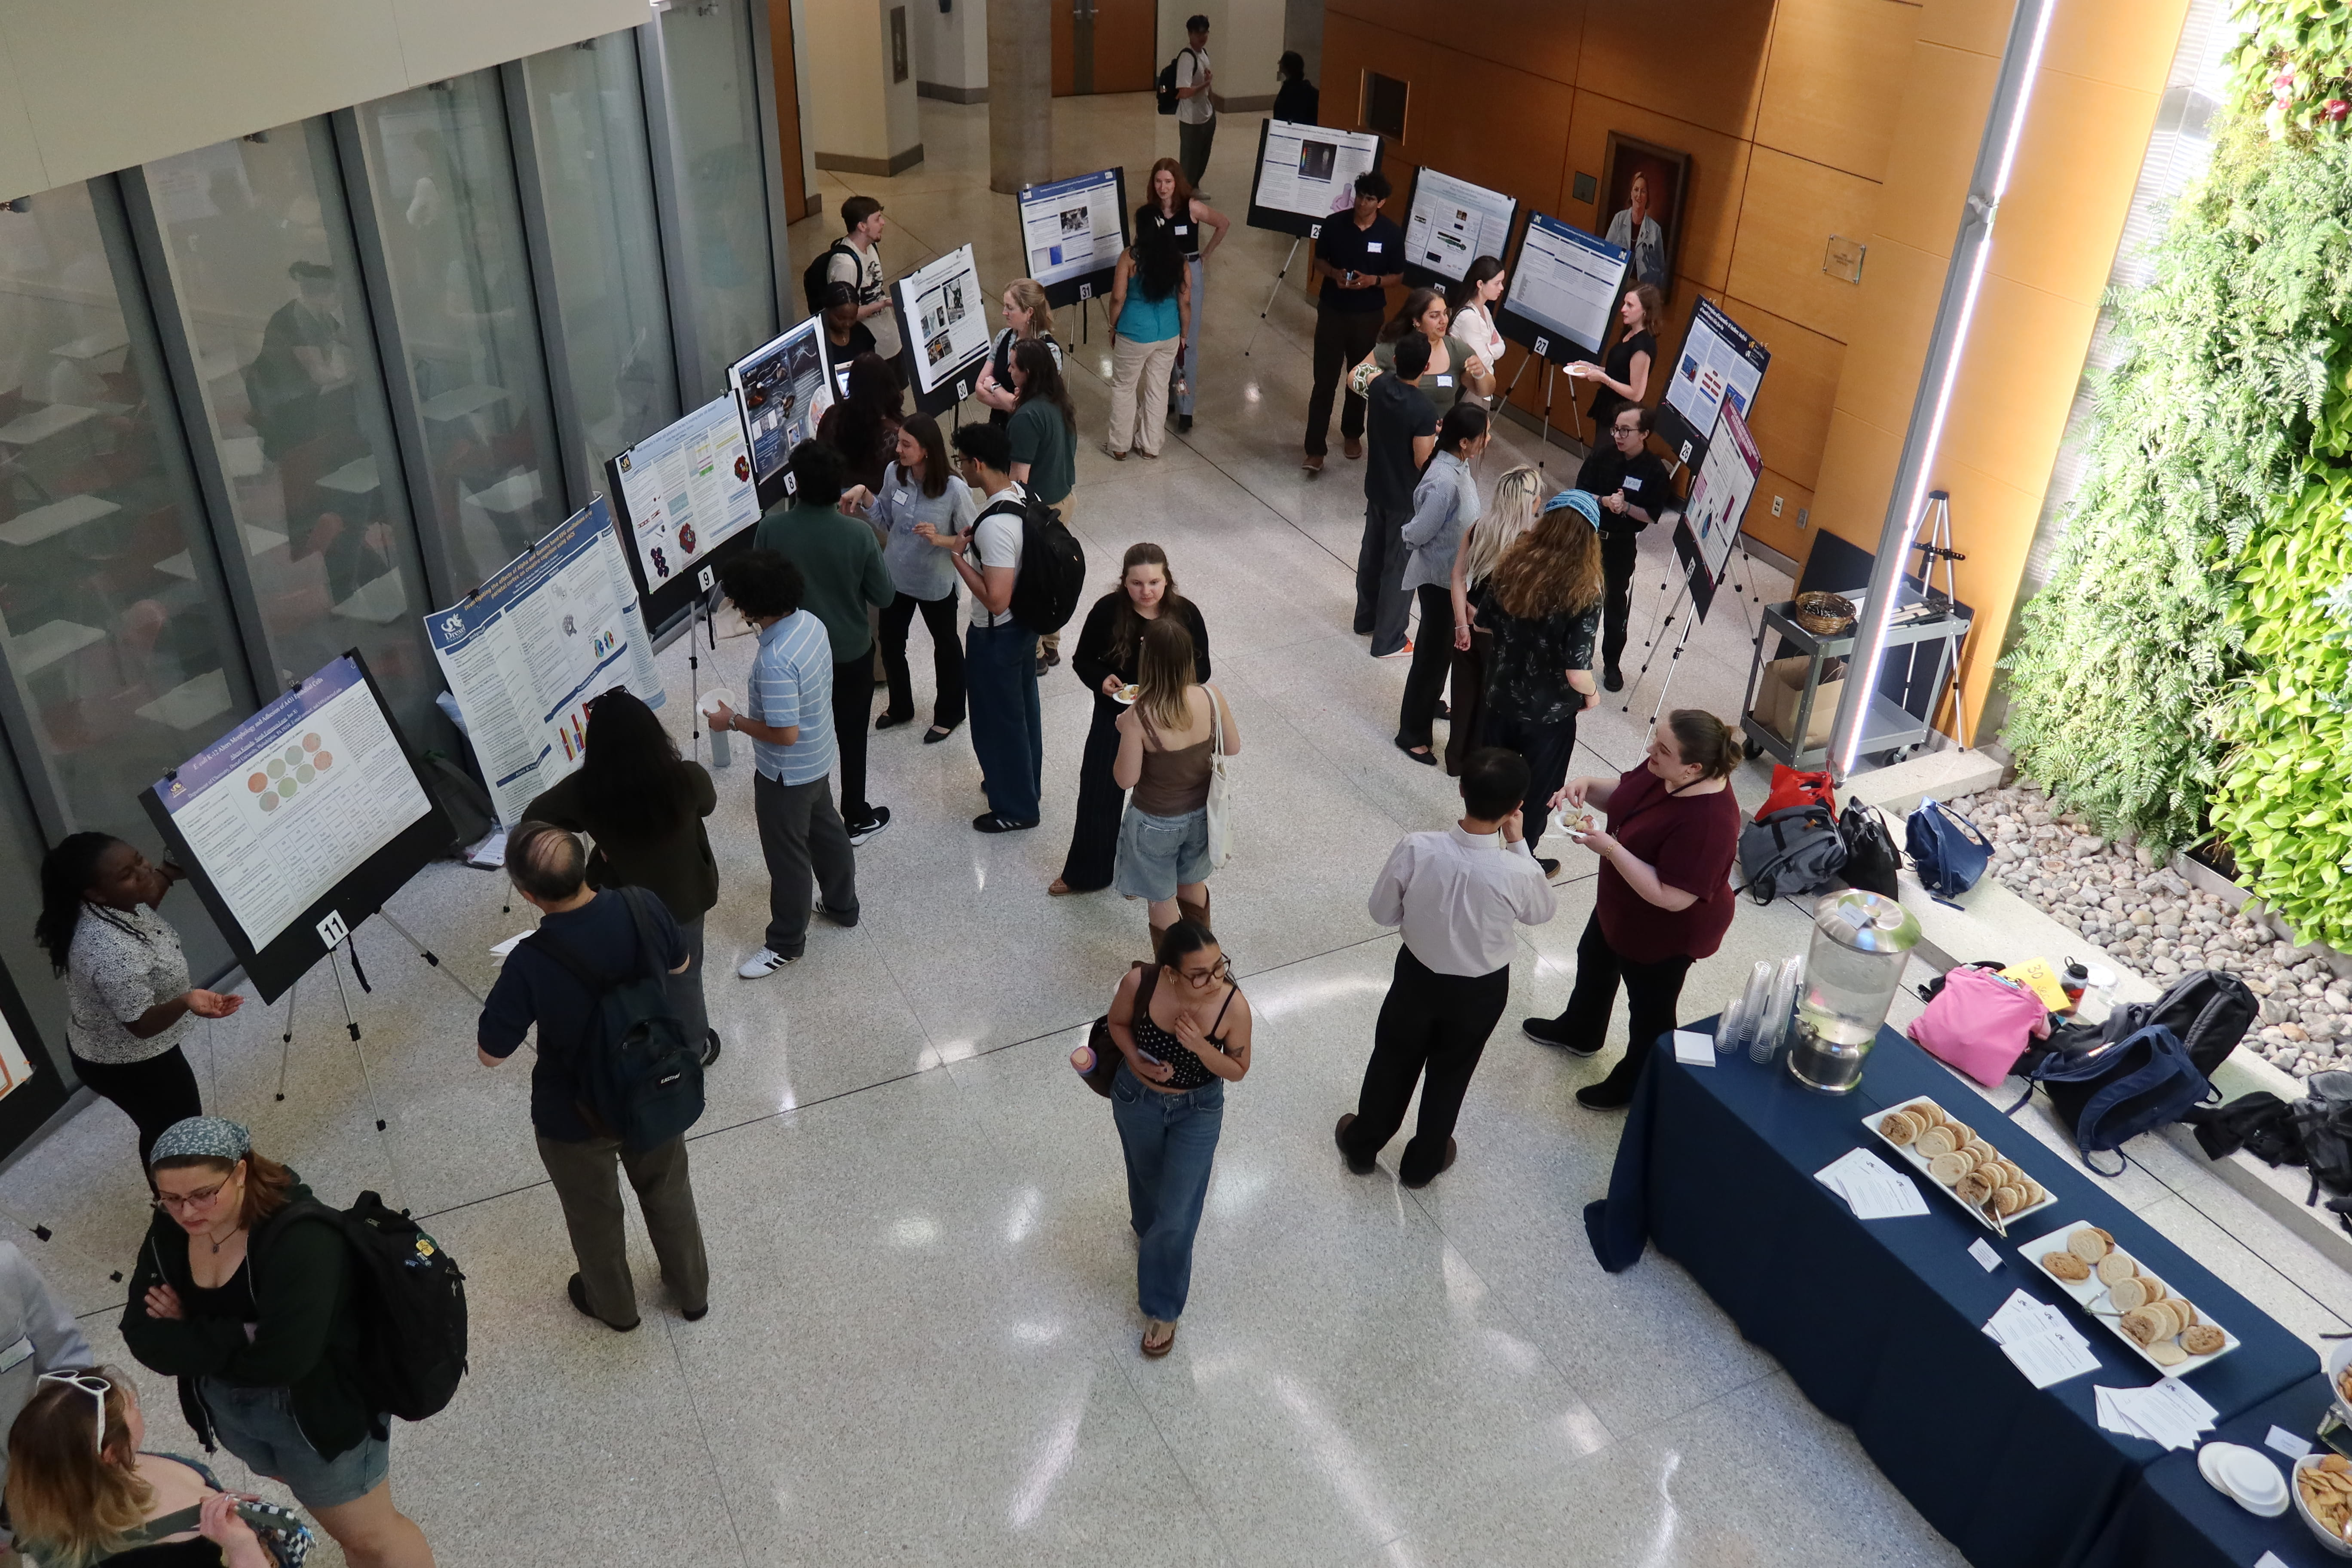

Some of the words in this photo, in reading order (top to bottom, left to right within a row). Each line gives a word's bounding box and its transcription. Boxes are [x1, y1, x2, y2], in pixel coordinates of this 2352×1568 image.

[1082, 285, 1090, 299] 31
[1536, 340, 1546, 353] 27
[958, 383, 965, 397] 30
[1681, 444, 1689, 459] 26
[788, 476, 794, 489] 8
[463, 587, 492, 611] Investigating
[490, 581, 499, 590] the
[498, 570, 513, 585] effects
[516, 558, 529, 570] Alpha
[527, 553, 536, 562] and
[536, 542, 551, 556] Gamma
[549, 536, 559, 546] band
[565, 515, 585, 533] oscillations
[490, 583, 507, 600] parietal
[506, 574, 519, 586] cortex
[524, 558, 541, 573] creative
[539, 545, 557, 562] cognition
[556, 538, 567, 548] using
[703, 573, 710, 586] 9
[206, 749, 219, 760] K-12
[217, 741, 231, 753] Alters
[230, 723, 257, 745] Morphology
[254, 718, 263, 727] and
[260, 705, 281, 722] Adhesion
[311, 676, 323, 687] Cells
[324, 917, 344, 941] 11
[2027, 964, 2044, 979] 30
